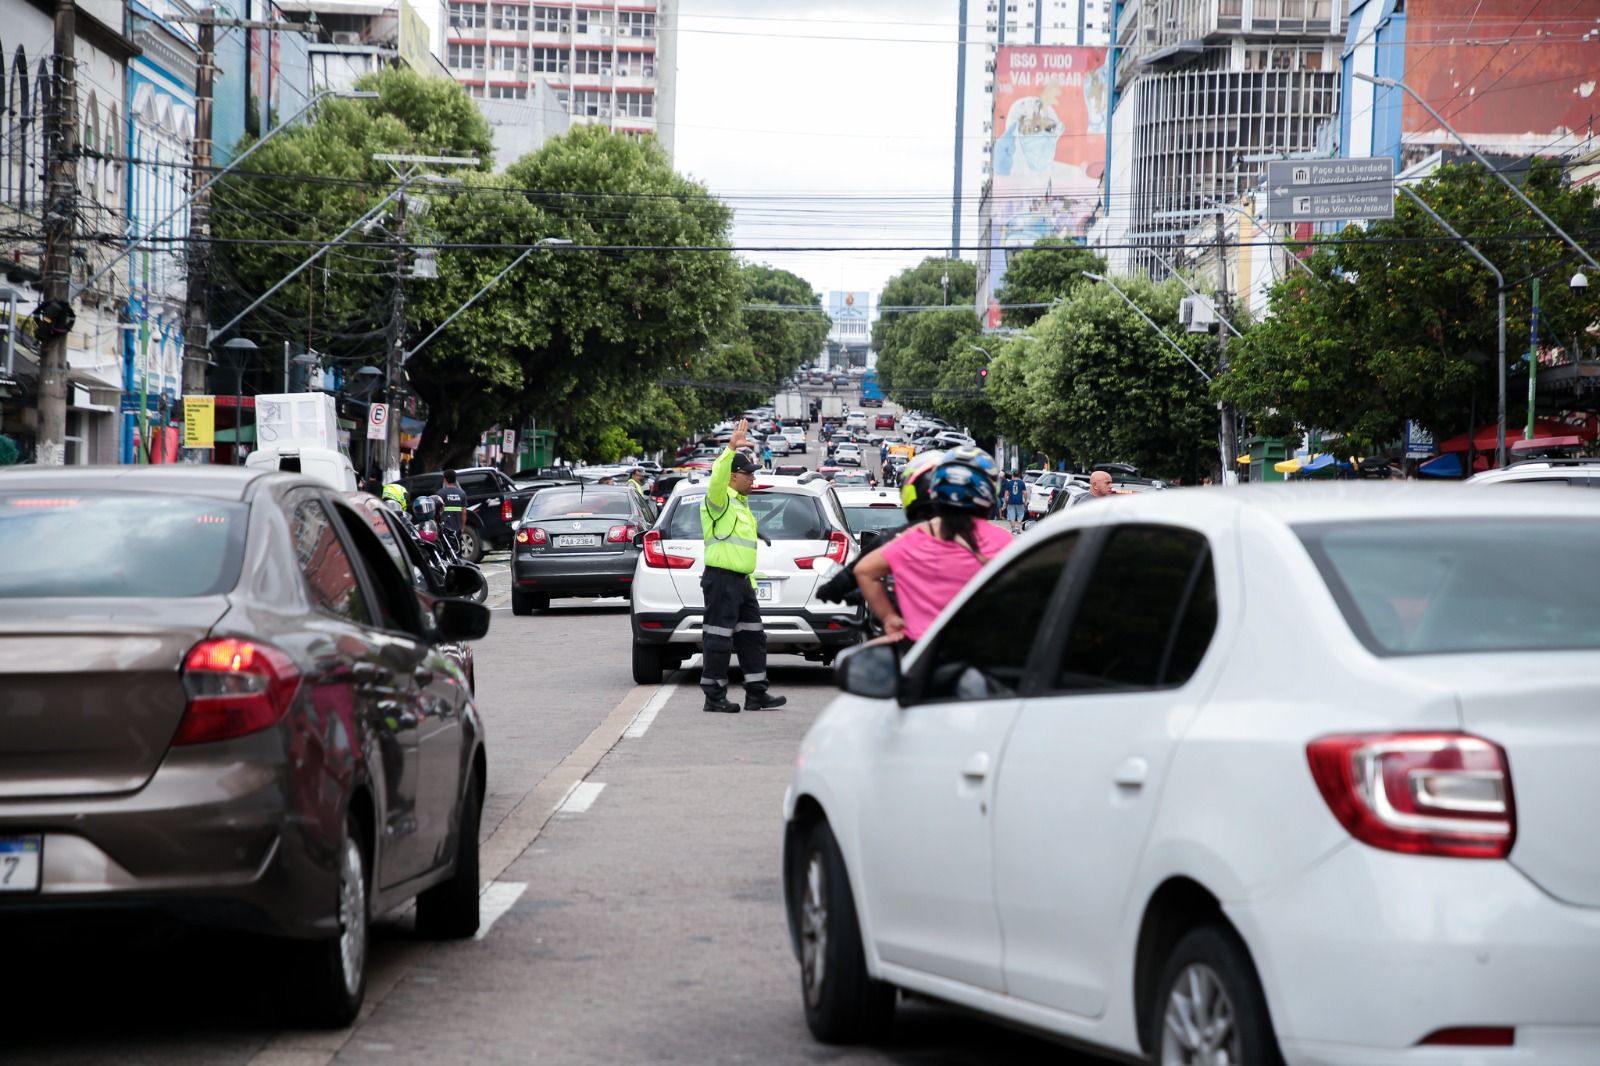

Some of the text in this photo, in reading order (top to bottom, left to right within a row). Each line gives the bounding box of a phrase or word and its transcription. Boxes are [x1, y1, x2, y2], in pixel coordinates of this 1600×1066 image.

[1009, 53, 1073, 69] ISSO TUDO
[1009, 71, 1081, 87] VAI PASSAR
[1312, 164, 1388, 175] Paço da Liberdade
[1331, 195, 1347, 204] São
[1348, 194, 1378, 203] Vicente
[1314, 203, 1389, 214] São Vicente Island
[374, 408, 383, 420] E
[3, 856, 20, 884] 7
